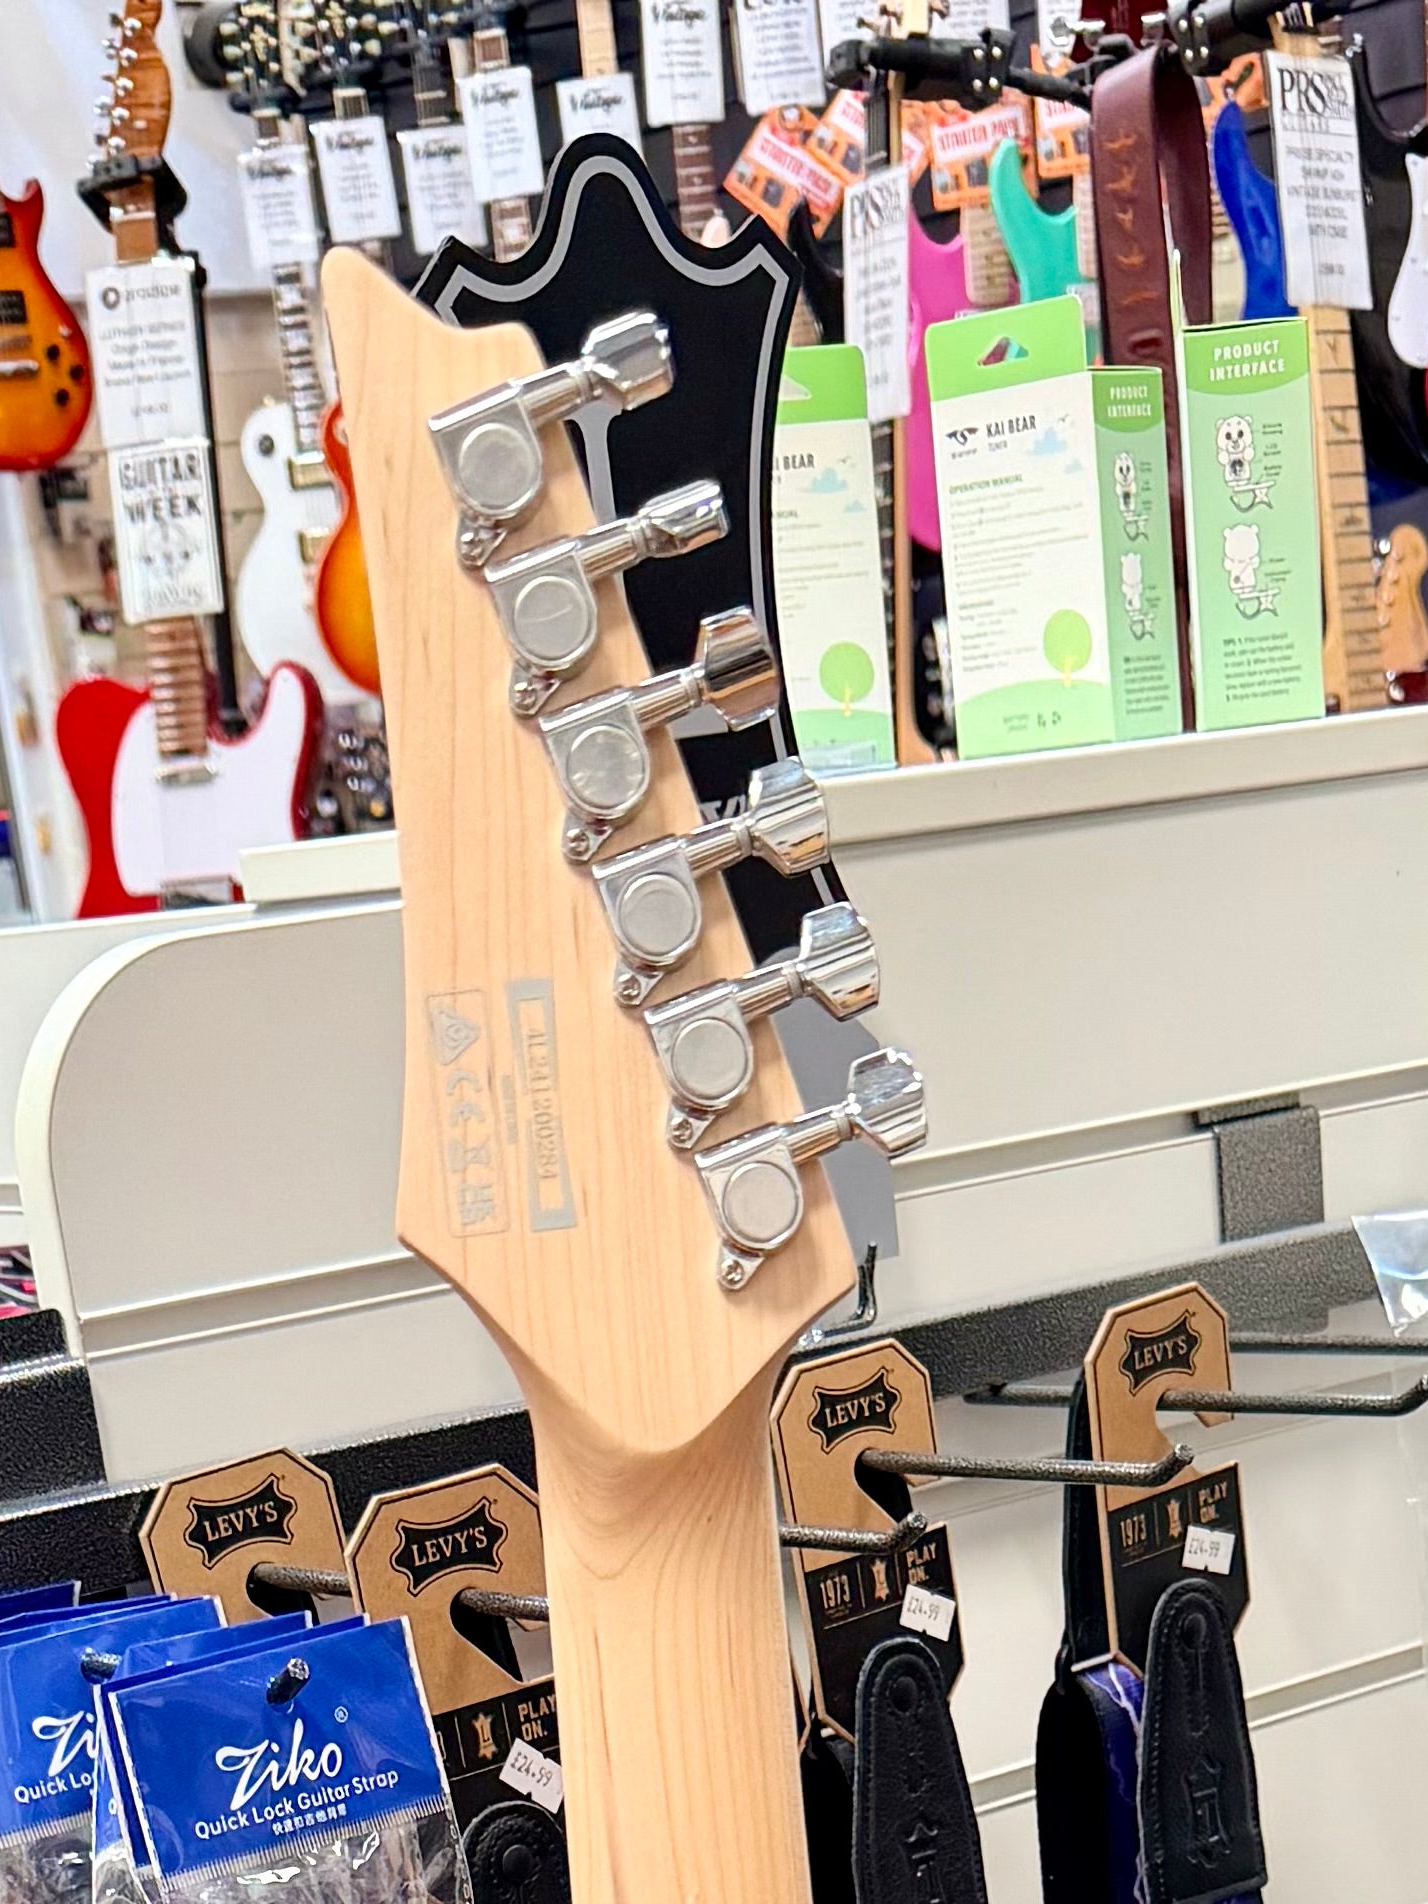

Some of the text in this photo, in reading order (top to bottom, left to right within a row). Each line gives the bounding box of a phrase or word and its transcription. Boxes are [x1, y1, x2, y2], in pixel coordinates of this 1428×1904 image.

[1277, 68, 1326, 115] PRS
[1214, 340, 1280, 361] PRODUCT
[1209, 358, 1286, 383] INTERFACE
[1110, 386, 1149, 400] PRODUCT
[986, 415, 1037, 438] KAI BEAR
[120, 453, 201, 491] GUITAR
[783, 453, 815, 471] BEAR
[124, 494, 203, 526] WEEK
[1134, 1336, 1188, 1372] LEVY'S
[824, 1391, 887, 1428] LEVY'S
[1198, 1481, 1228, 1507] PLAY
[203, 1501, 278, 1542] LEVY'S
[1120, 1513, 1147, 1548] 1973
[411, 1525, 488, 1567] LEVY'S
[906, 1543, 936, 1568] PLAY
[820, 1574, 851, 1610] 1973
[518, 1694, 556, 1723] PLAY
[32, 1711, 101, 1777] Zi
[522, 1720, 548, 1742] ON.
[216, 1717, 343, 1812] Ziko
[510, 1753, 554, 1787] £24.99
[14, 1774, 68, 1804] Quick
[195, 1769, 400, 1840] Quick Lock Guitar Strap
